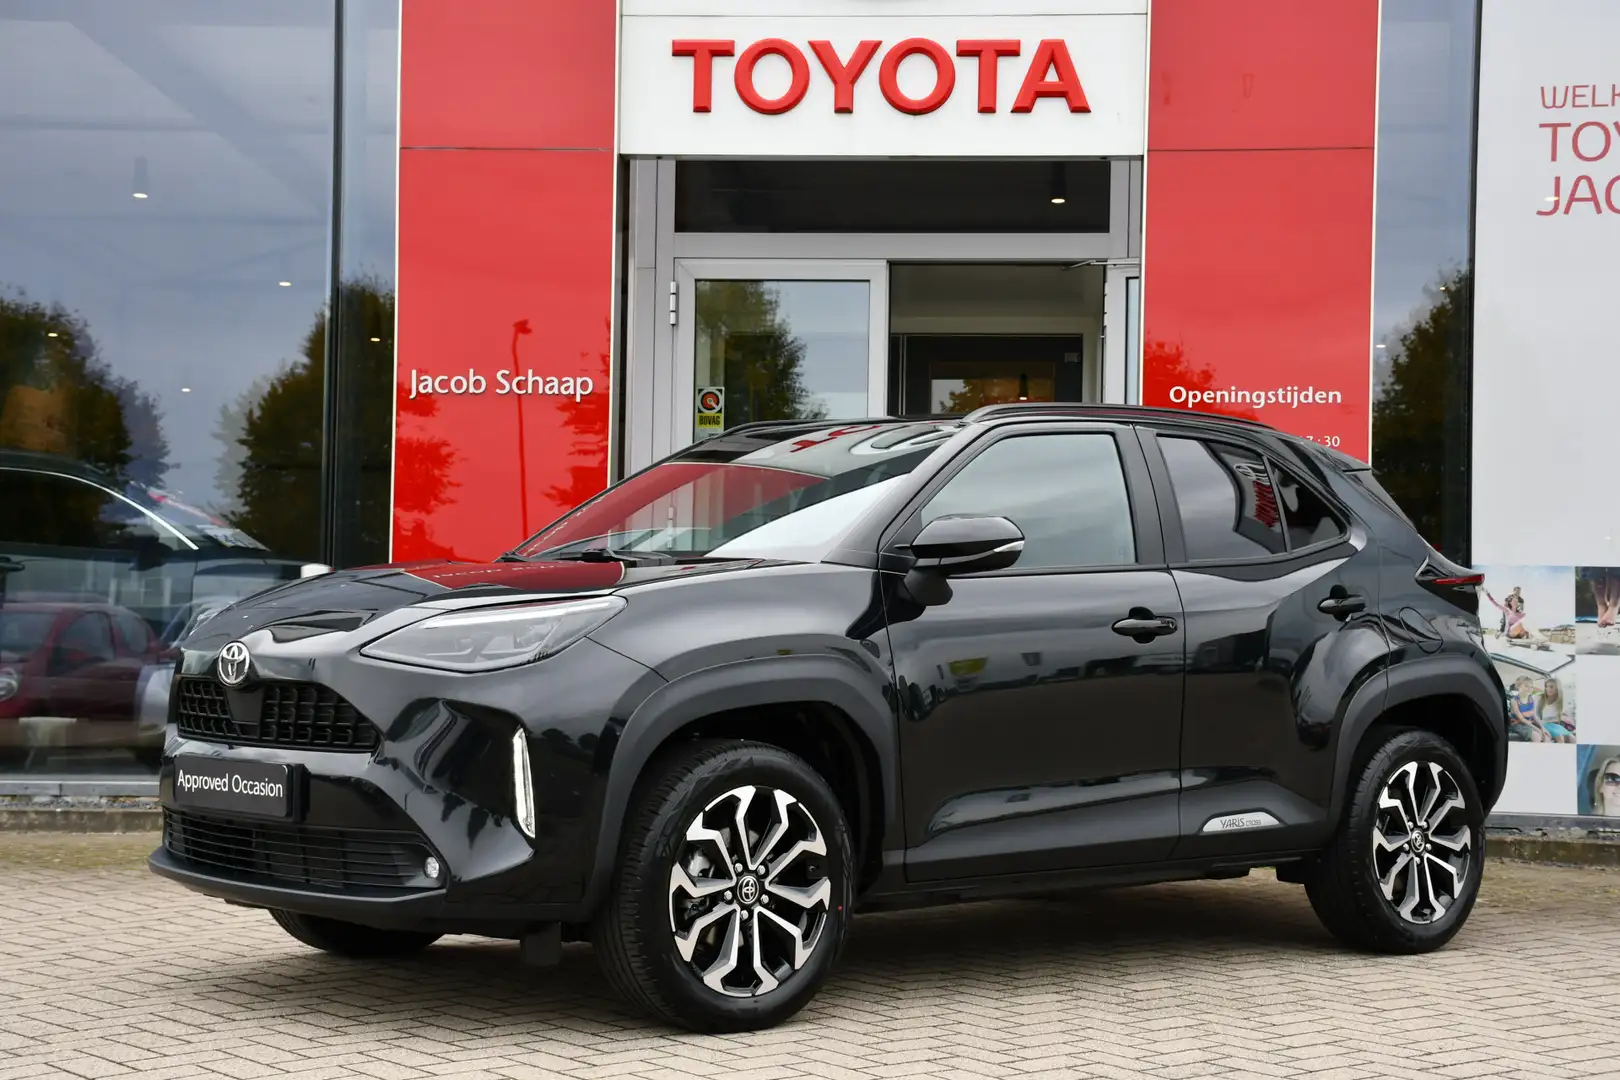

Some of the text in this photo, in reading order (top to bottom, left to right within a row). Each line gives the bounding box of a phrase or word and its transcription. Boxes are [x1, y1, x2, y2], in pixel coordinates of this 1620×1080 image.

[672, 37, 1092, 115] TOYOTA
[1539, 121, 1620, 162] TO
[409, 368, 594, 402] Jacob Schaap
[1169, 386, 1342, 409] Openingstijden
[699, 415, 721, 426] BOVAG
[177, 769, 283, 798] Approved Occasion
